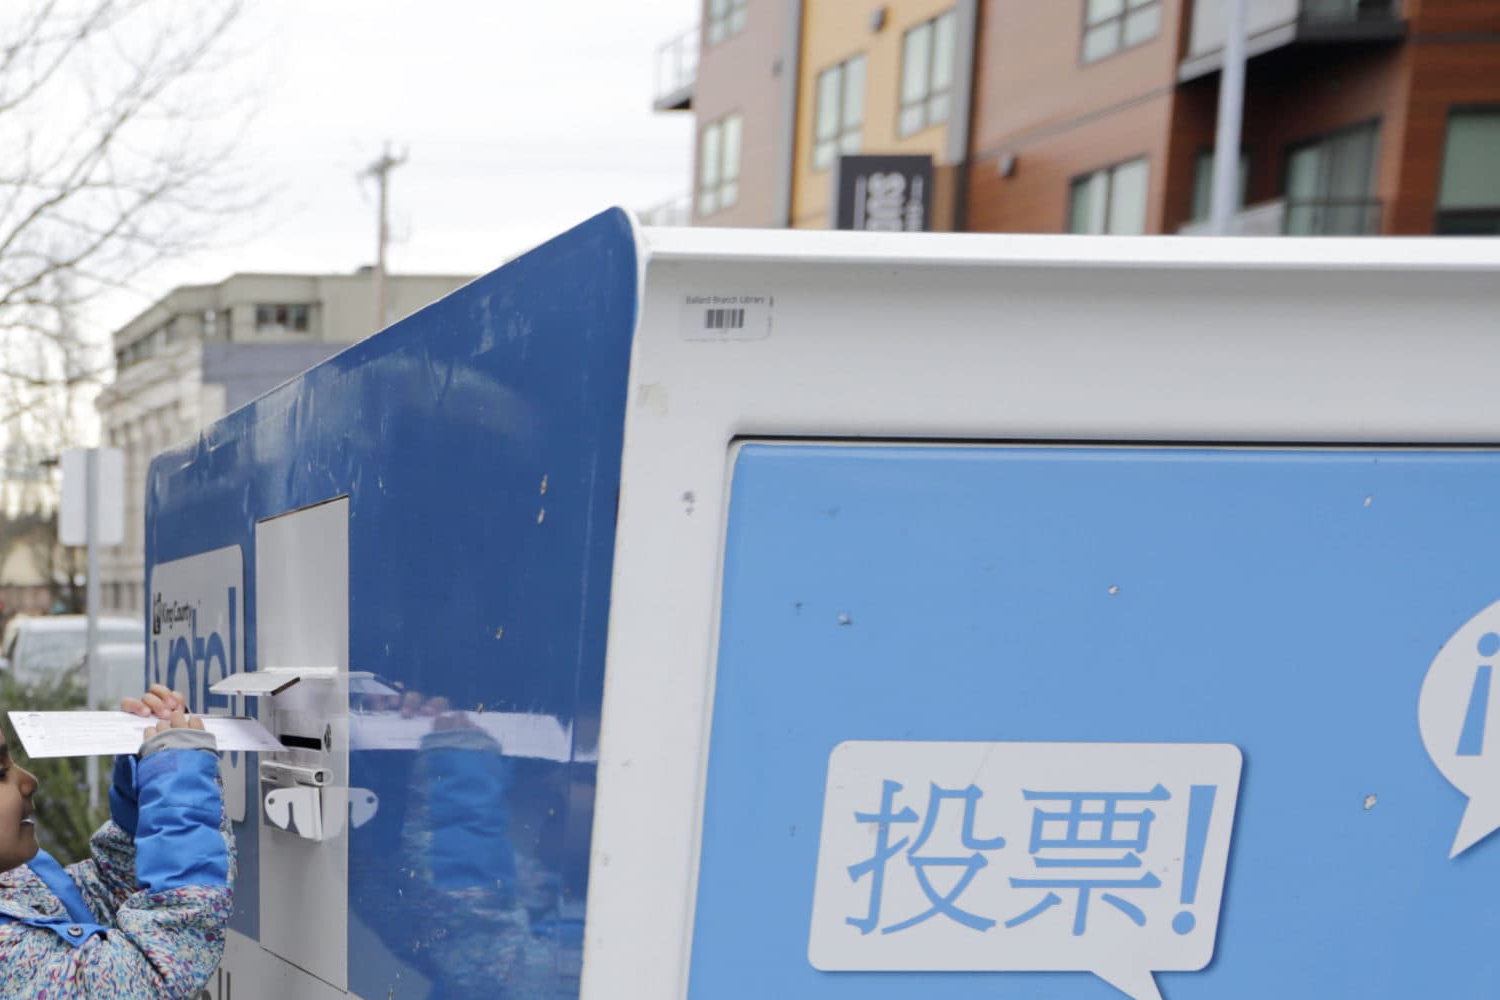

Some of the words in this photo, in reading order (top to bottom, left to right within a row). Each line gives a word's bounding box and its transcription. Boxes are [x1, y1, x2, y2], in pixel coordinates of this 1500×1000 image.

[712, 295, 737, 305] Branch
[739, 296, 765, 306] Library
[161, 603, 173, 629] King
[173, 600, 192, 627] County
[844, 778, 1219, 937] 投票!
